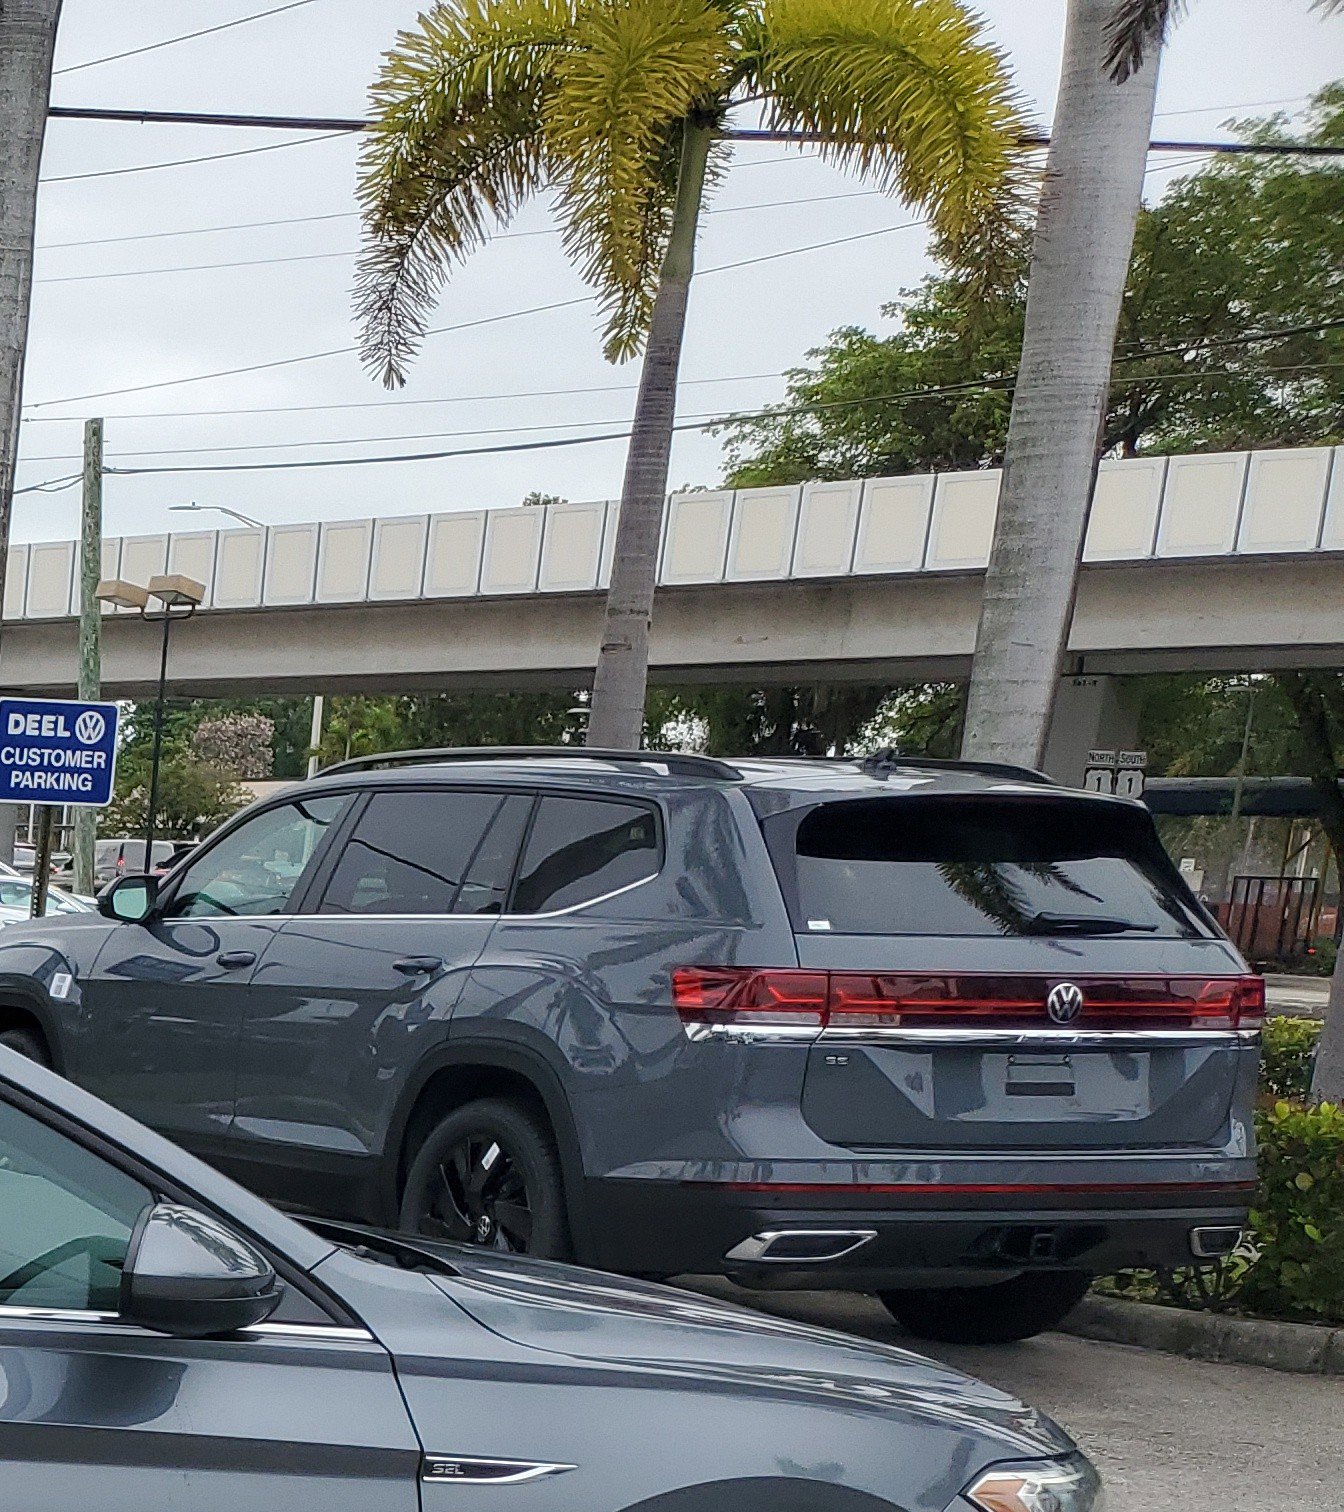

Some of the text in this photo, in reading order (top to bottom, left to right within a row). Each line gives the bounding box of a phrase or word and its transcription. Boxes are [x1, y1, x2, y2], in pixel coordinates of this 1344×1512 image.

[7, 713, 71, 737] DEEL
[0, 746, 106, 769] CUSTOMER
[10, 770, 93, 791] PARKING
[1095, 776, 1102, 793] 1
[1127, 777, 1134, 795] 1
[431, 1463, 465, 1475] SEL
